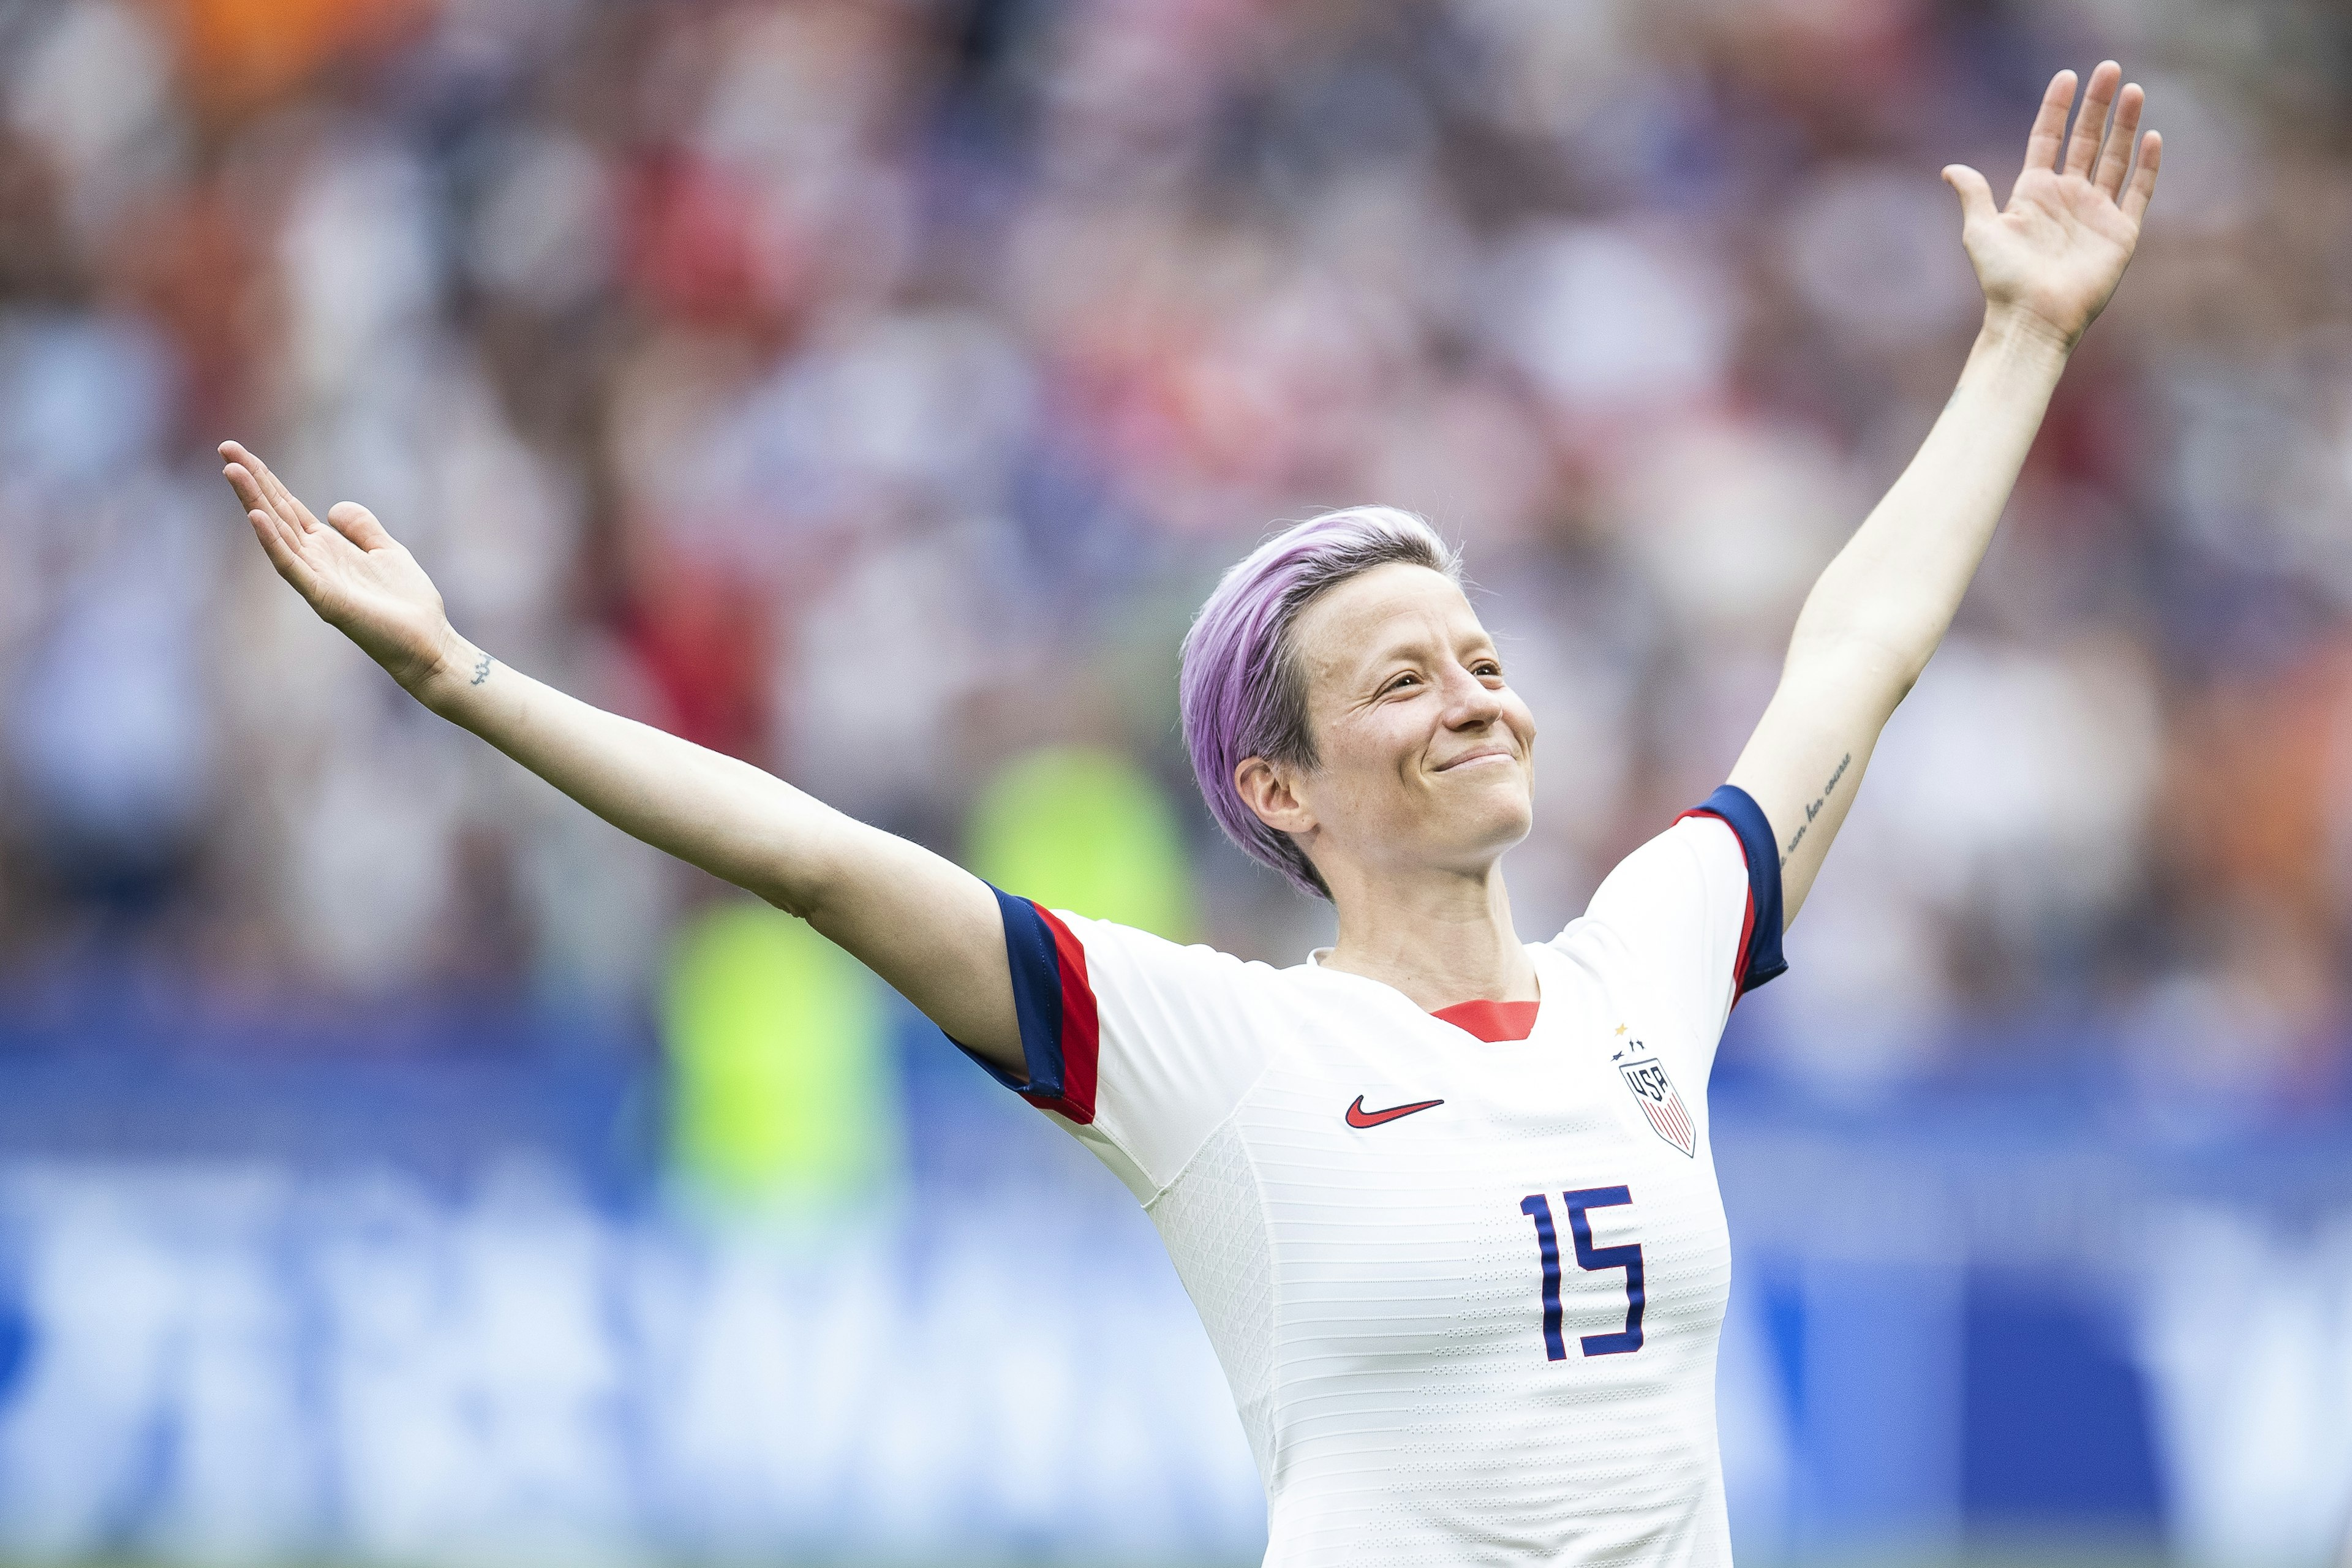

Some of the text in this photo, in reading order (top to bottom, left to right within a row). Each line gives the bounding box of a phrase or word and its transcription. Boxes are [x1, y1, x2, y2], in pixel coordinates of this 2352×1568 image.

[1806, 797, 1824, 823] her
[1627, 1066, 1668, 1102] USA
[1520, 1185, 1645, 1362] 15
